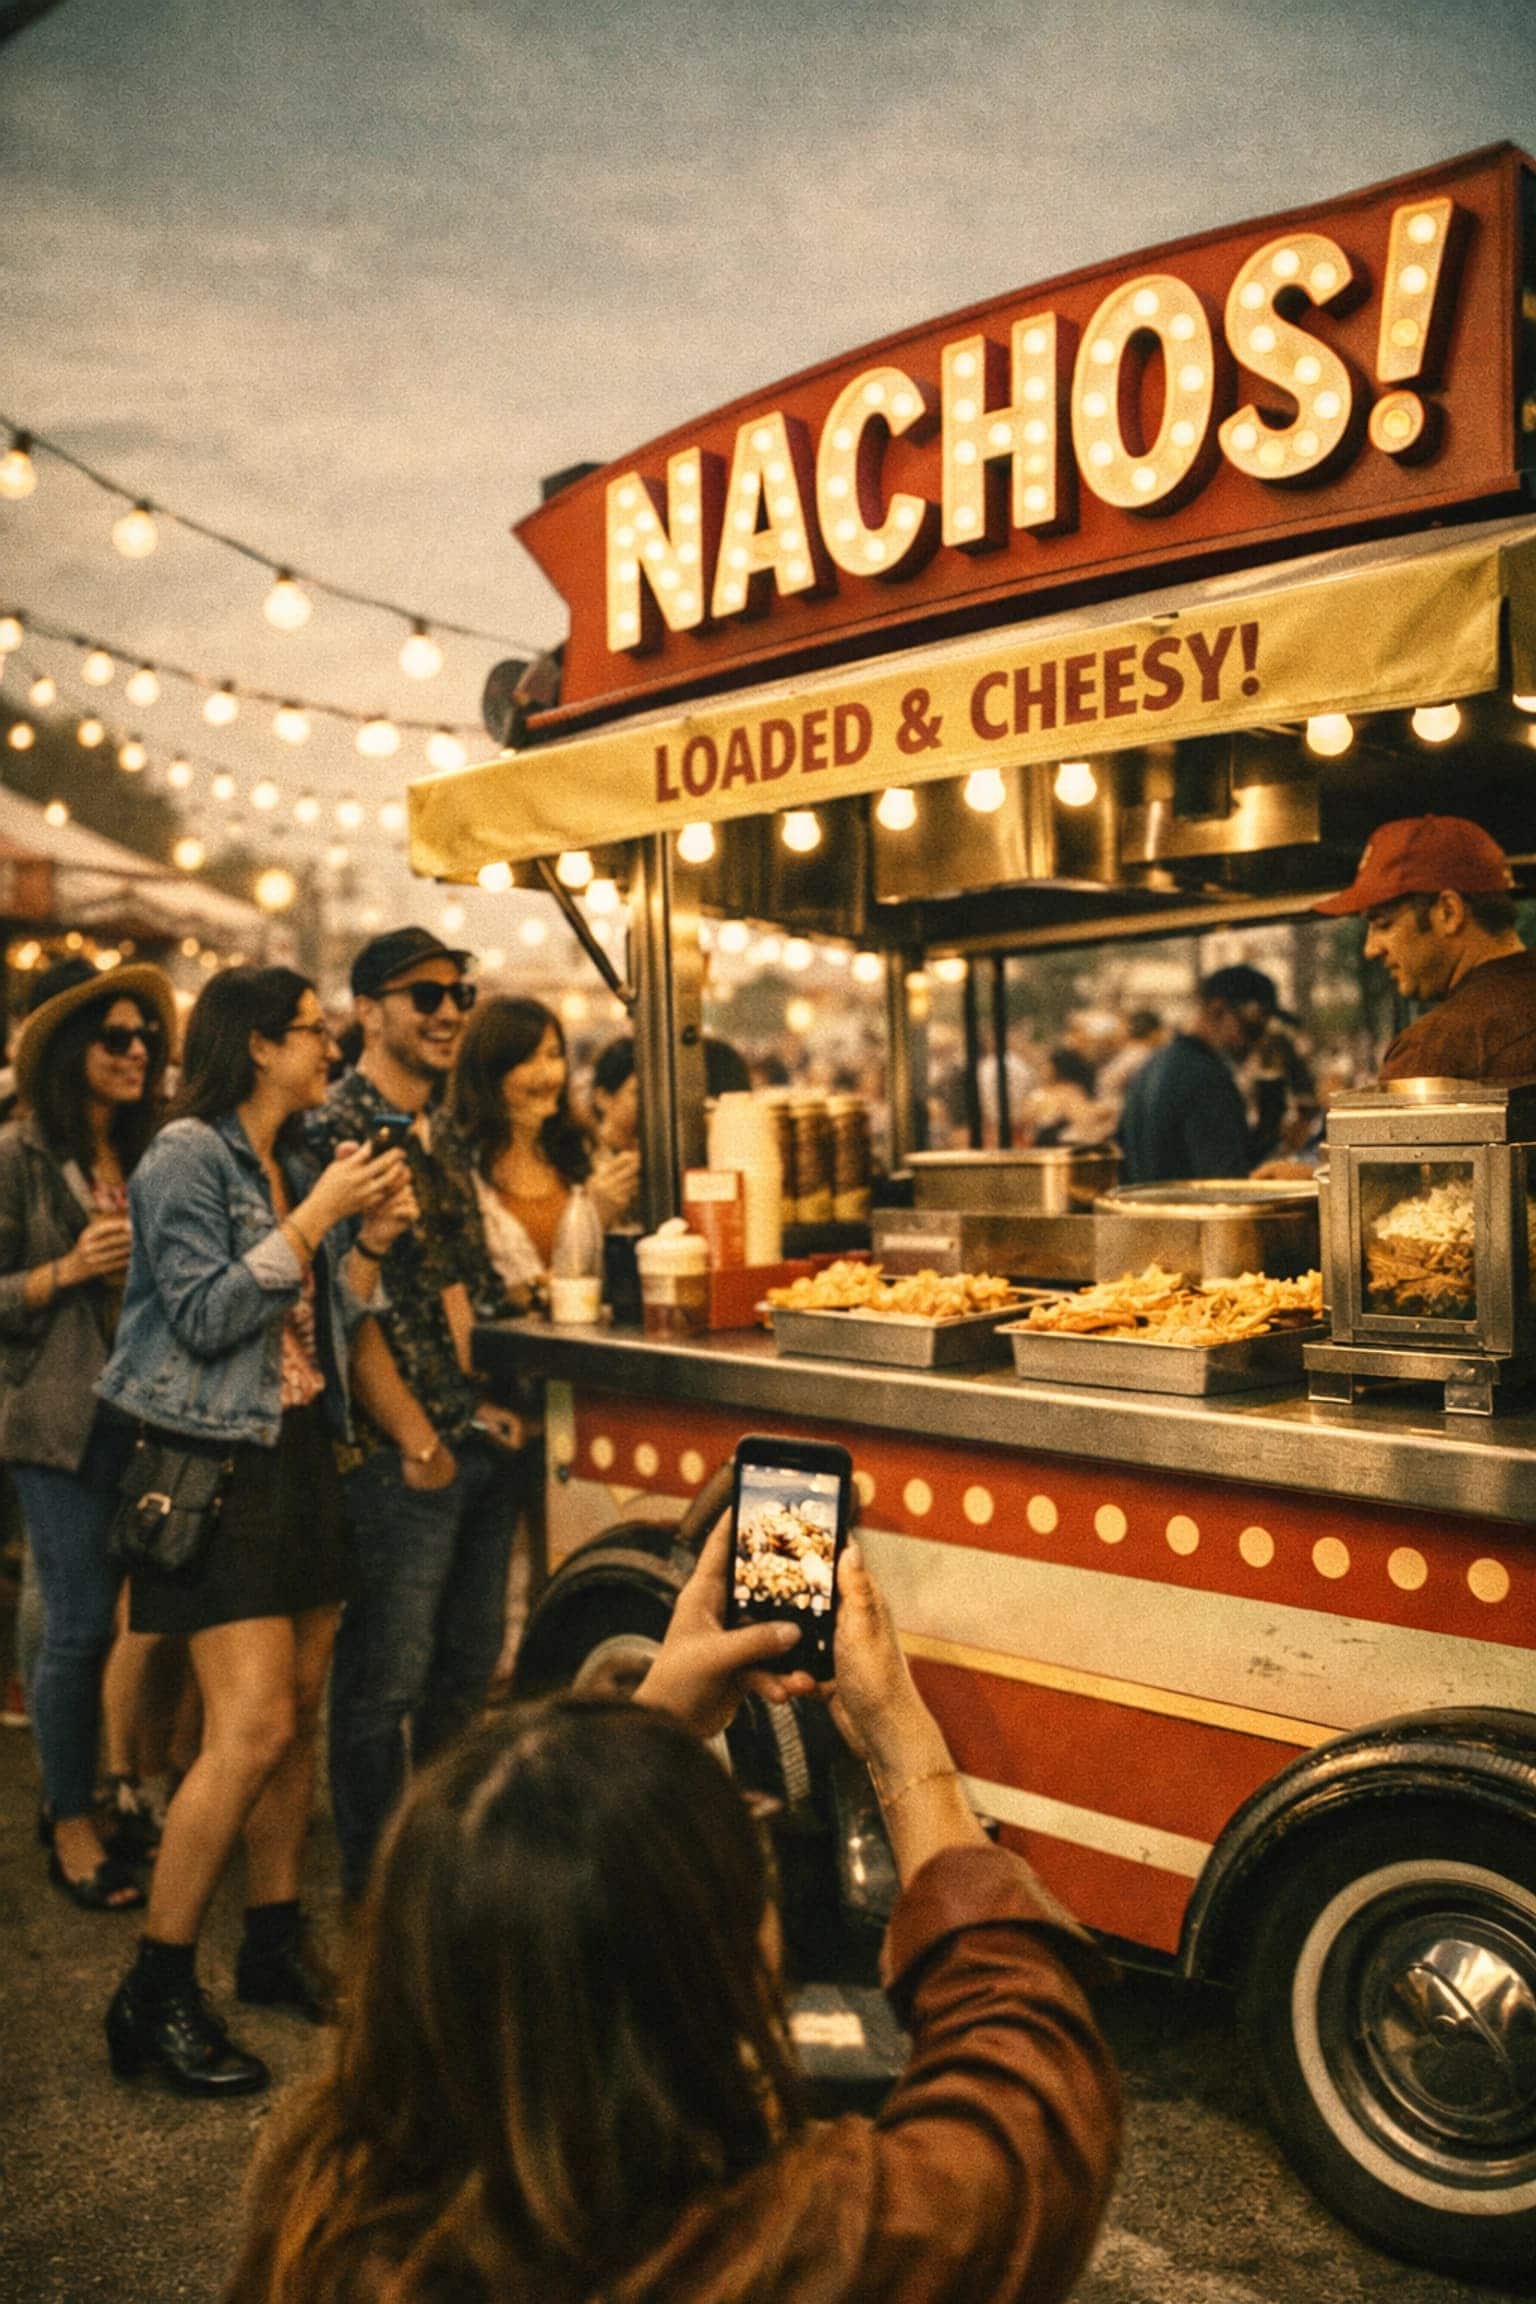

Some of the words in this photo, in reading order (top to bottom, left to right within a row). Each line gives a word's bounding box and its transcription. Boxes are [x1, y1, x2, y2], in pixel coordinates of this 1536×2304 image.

[606, 197, 1452, 652] NACHOS!
[655, 702, 872, 801] LOADED
[897, 687, 943, 755] &
[970, 621, 1260, 741] CHEESY!
